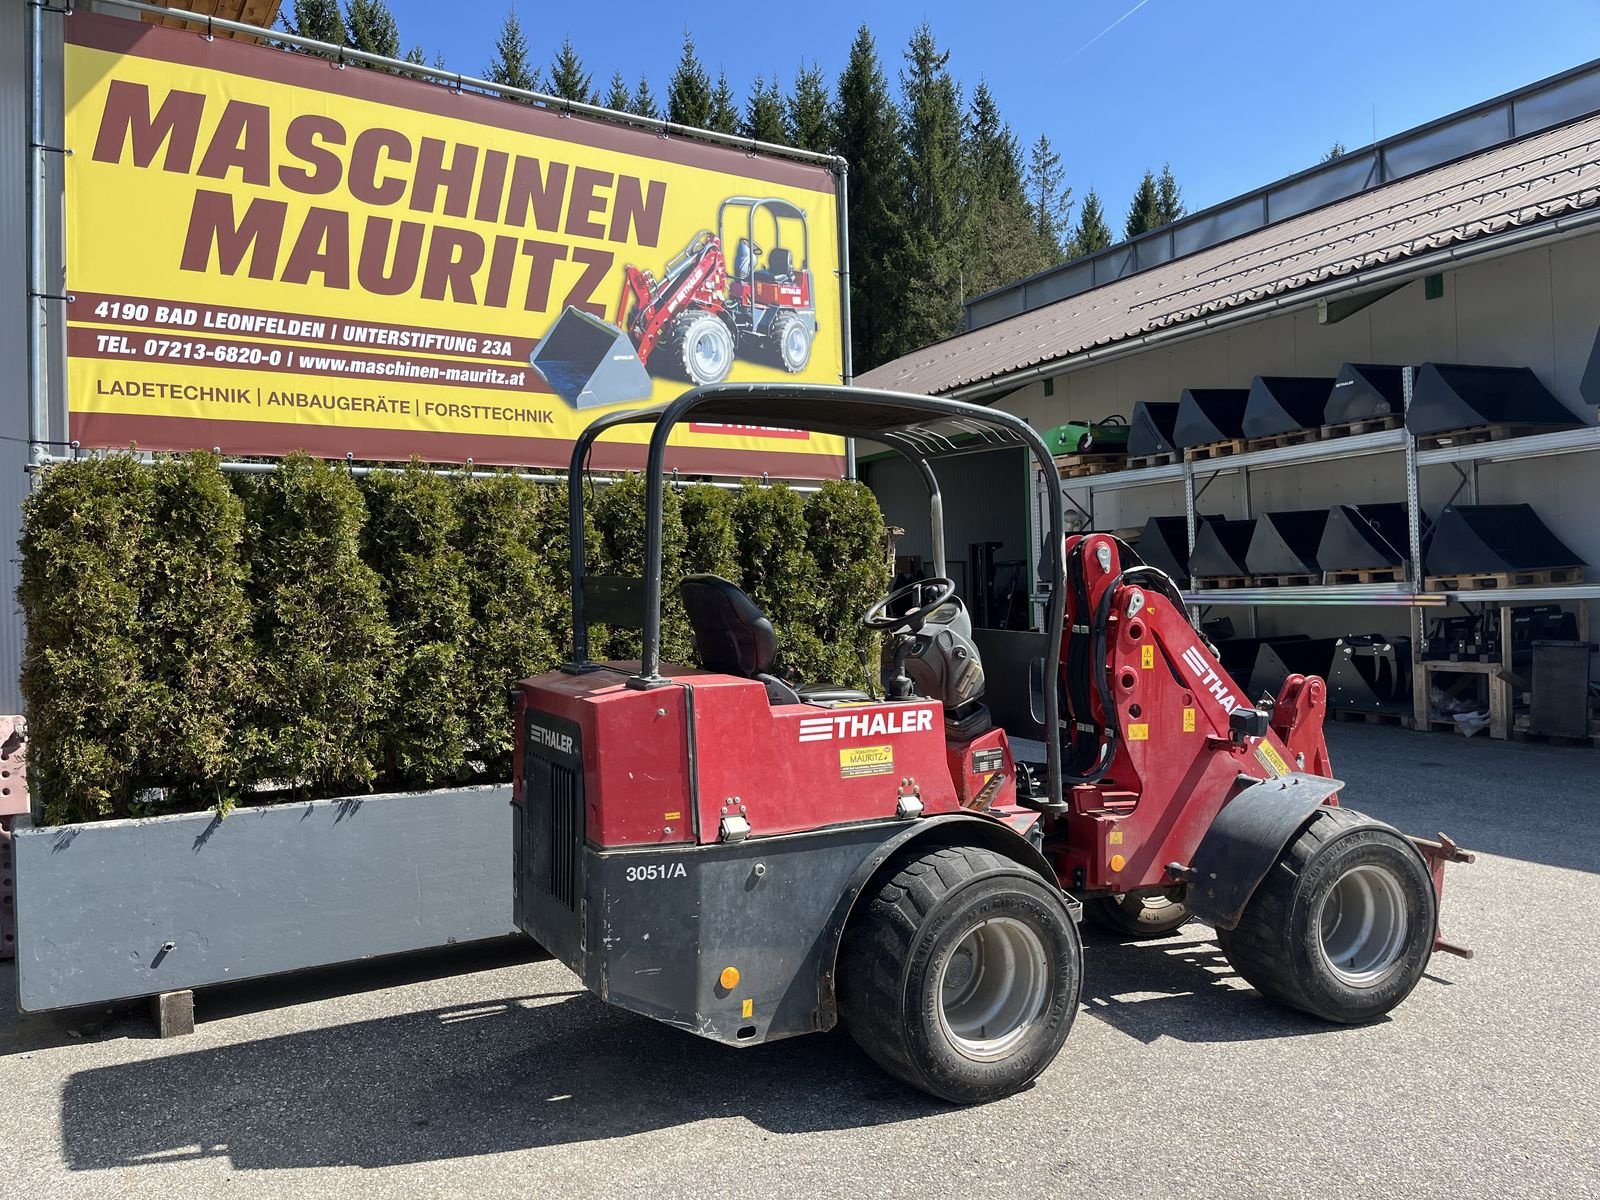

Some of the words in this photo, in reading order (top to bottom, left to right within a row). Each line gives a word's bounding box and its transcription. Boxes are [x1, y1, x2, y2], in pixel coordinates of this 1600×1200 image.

[92, 79, 667, 248] MASCHINEN
[179, 188, 616, 320] MAURITZ
[94, 301, 149, 322] 4190
[154, 306, 198, 326] BAD
[203, 311, 326, 339] LEONFELDEN
[342, 325, 478, 353] UNTERSTIFTUNG
[480, 339, 512, 357] 23A
[96, 334, 137, 355] TEL.
[143, 338, 282, 367] 07213-6820-0
[299, 355, 526, 387] www.maschinen-mauritz.at
[97, 379, 252, 405] LADETECHNIK
[266, 390, 411, 415] ANBAUGERÄTE
[424, 402, 555, 425] FORSTTECHNIK
[539, 728, 574, 755] THALER
[834, 709, 933, 739] THALER
[850, 752, 884, 764] MAURITZ
[625, 862, 688, 882] 3051/A
